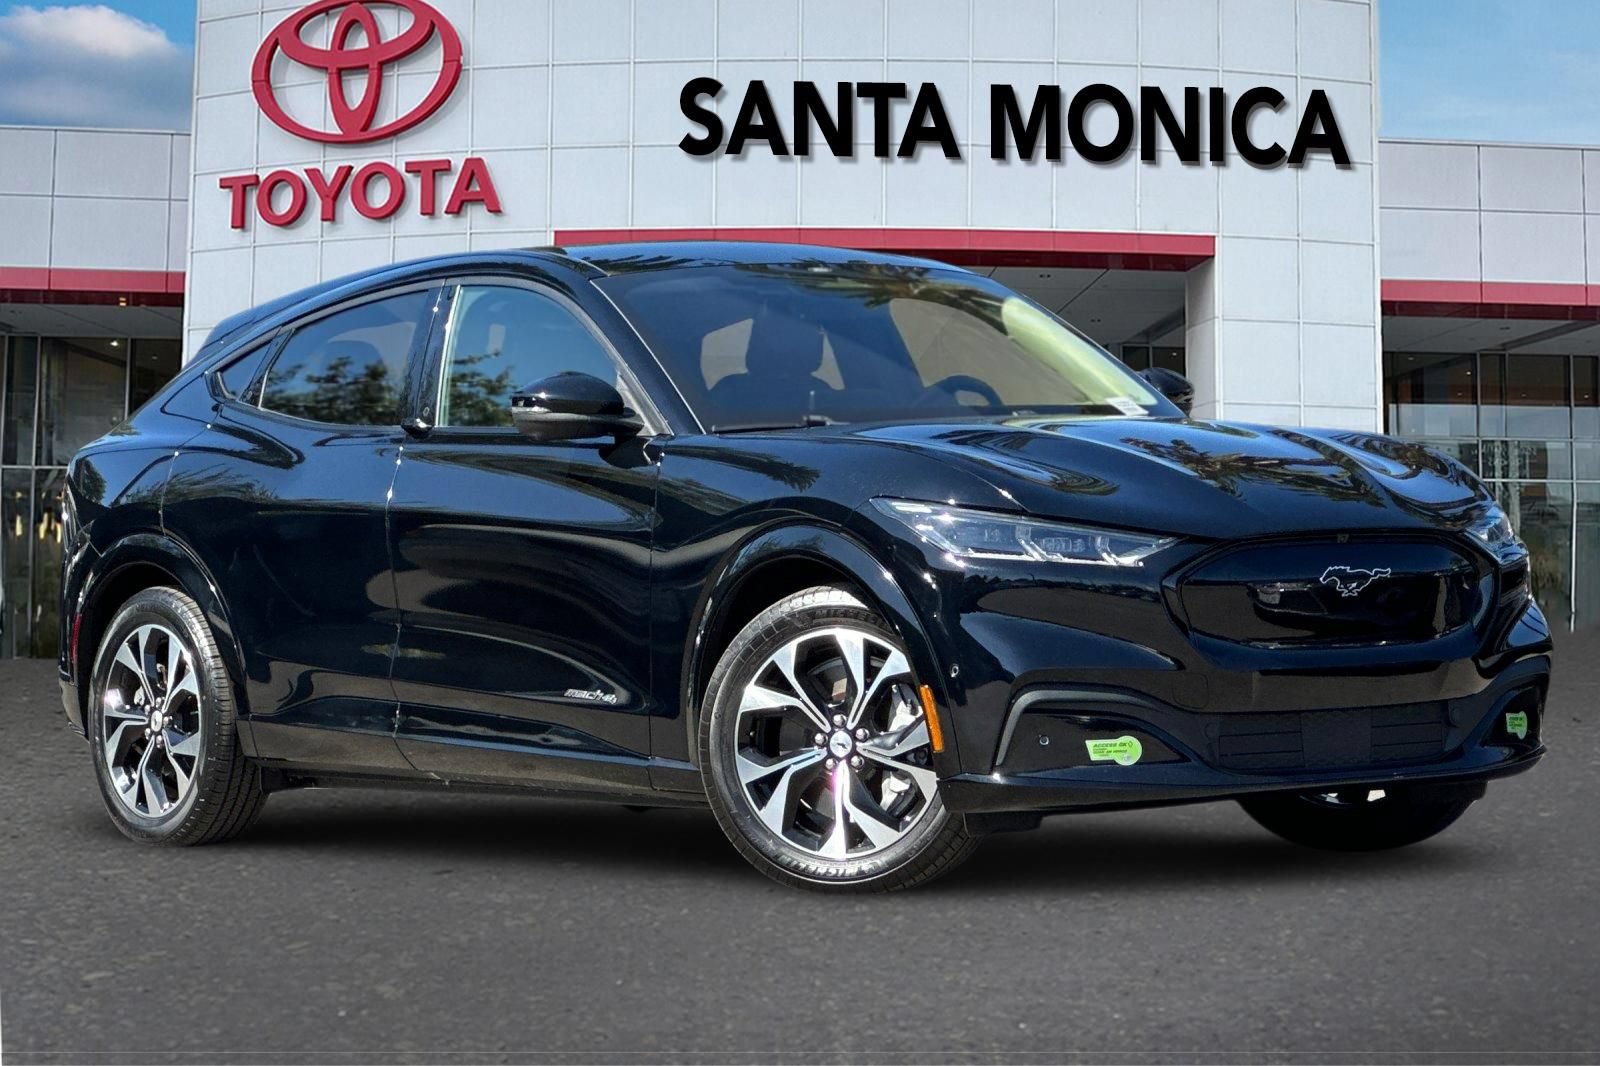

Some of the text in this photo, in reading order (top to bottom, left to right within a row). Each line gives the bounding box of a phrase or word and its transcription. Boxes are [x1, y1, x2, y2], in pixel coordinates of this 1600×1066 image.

[678, 77, 1351, 168] SANTA MONICA
[219, 157, 502, 229] TOYOTA
